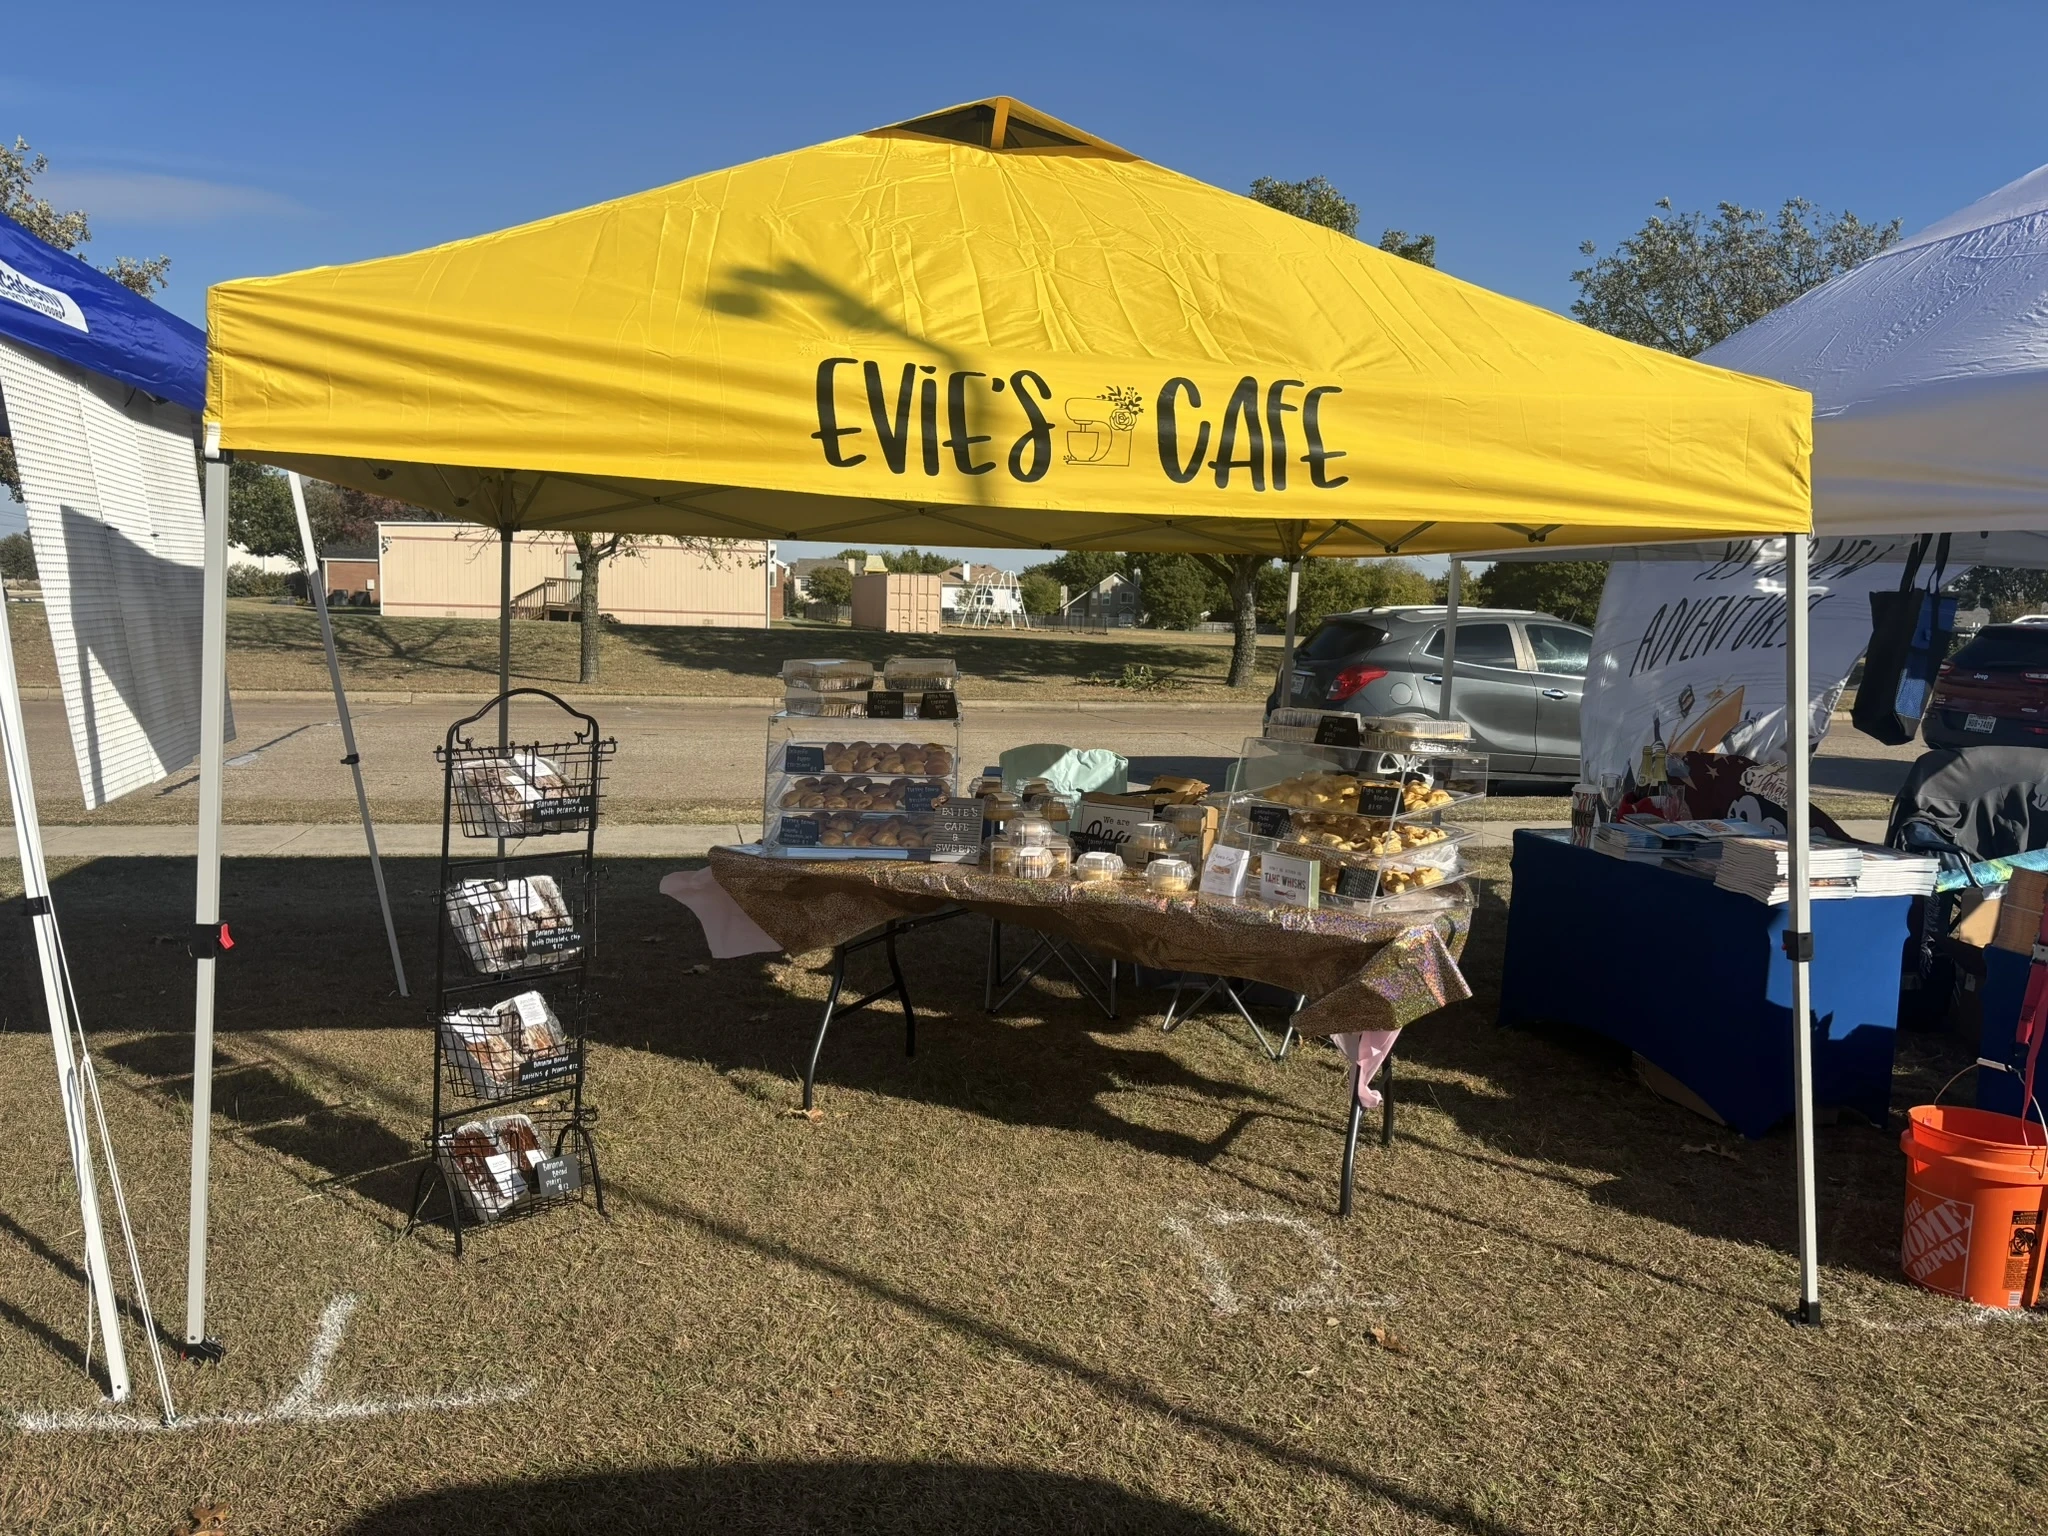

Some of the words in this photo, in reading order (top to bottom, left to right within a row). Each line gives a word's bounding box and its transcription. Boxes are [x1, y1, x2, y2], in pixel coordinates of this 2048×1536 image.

[0, 269, 65, 317] cademy
[1157, 376, 1349, 492] CAFE
[1973, 672, 1988, 680] Jeep
[535, 800, 559, 809] Banana
[562, 797, 581, 806] Bread
[941, 807, 978, 817] EVIE'S
[1102, 815, 1115, 825] We
[944, 822, 969, 832] CAFE
[935, 843, 977, 854] SWEETS
[1264, 872, 1281, 885] TAKE
[1281, 875, 1306, 890] WHISKS
[542, 1160, 564, 1172] Banana
[1912, 1236, 1968, 1280] DEPOT
